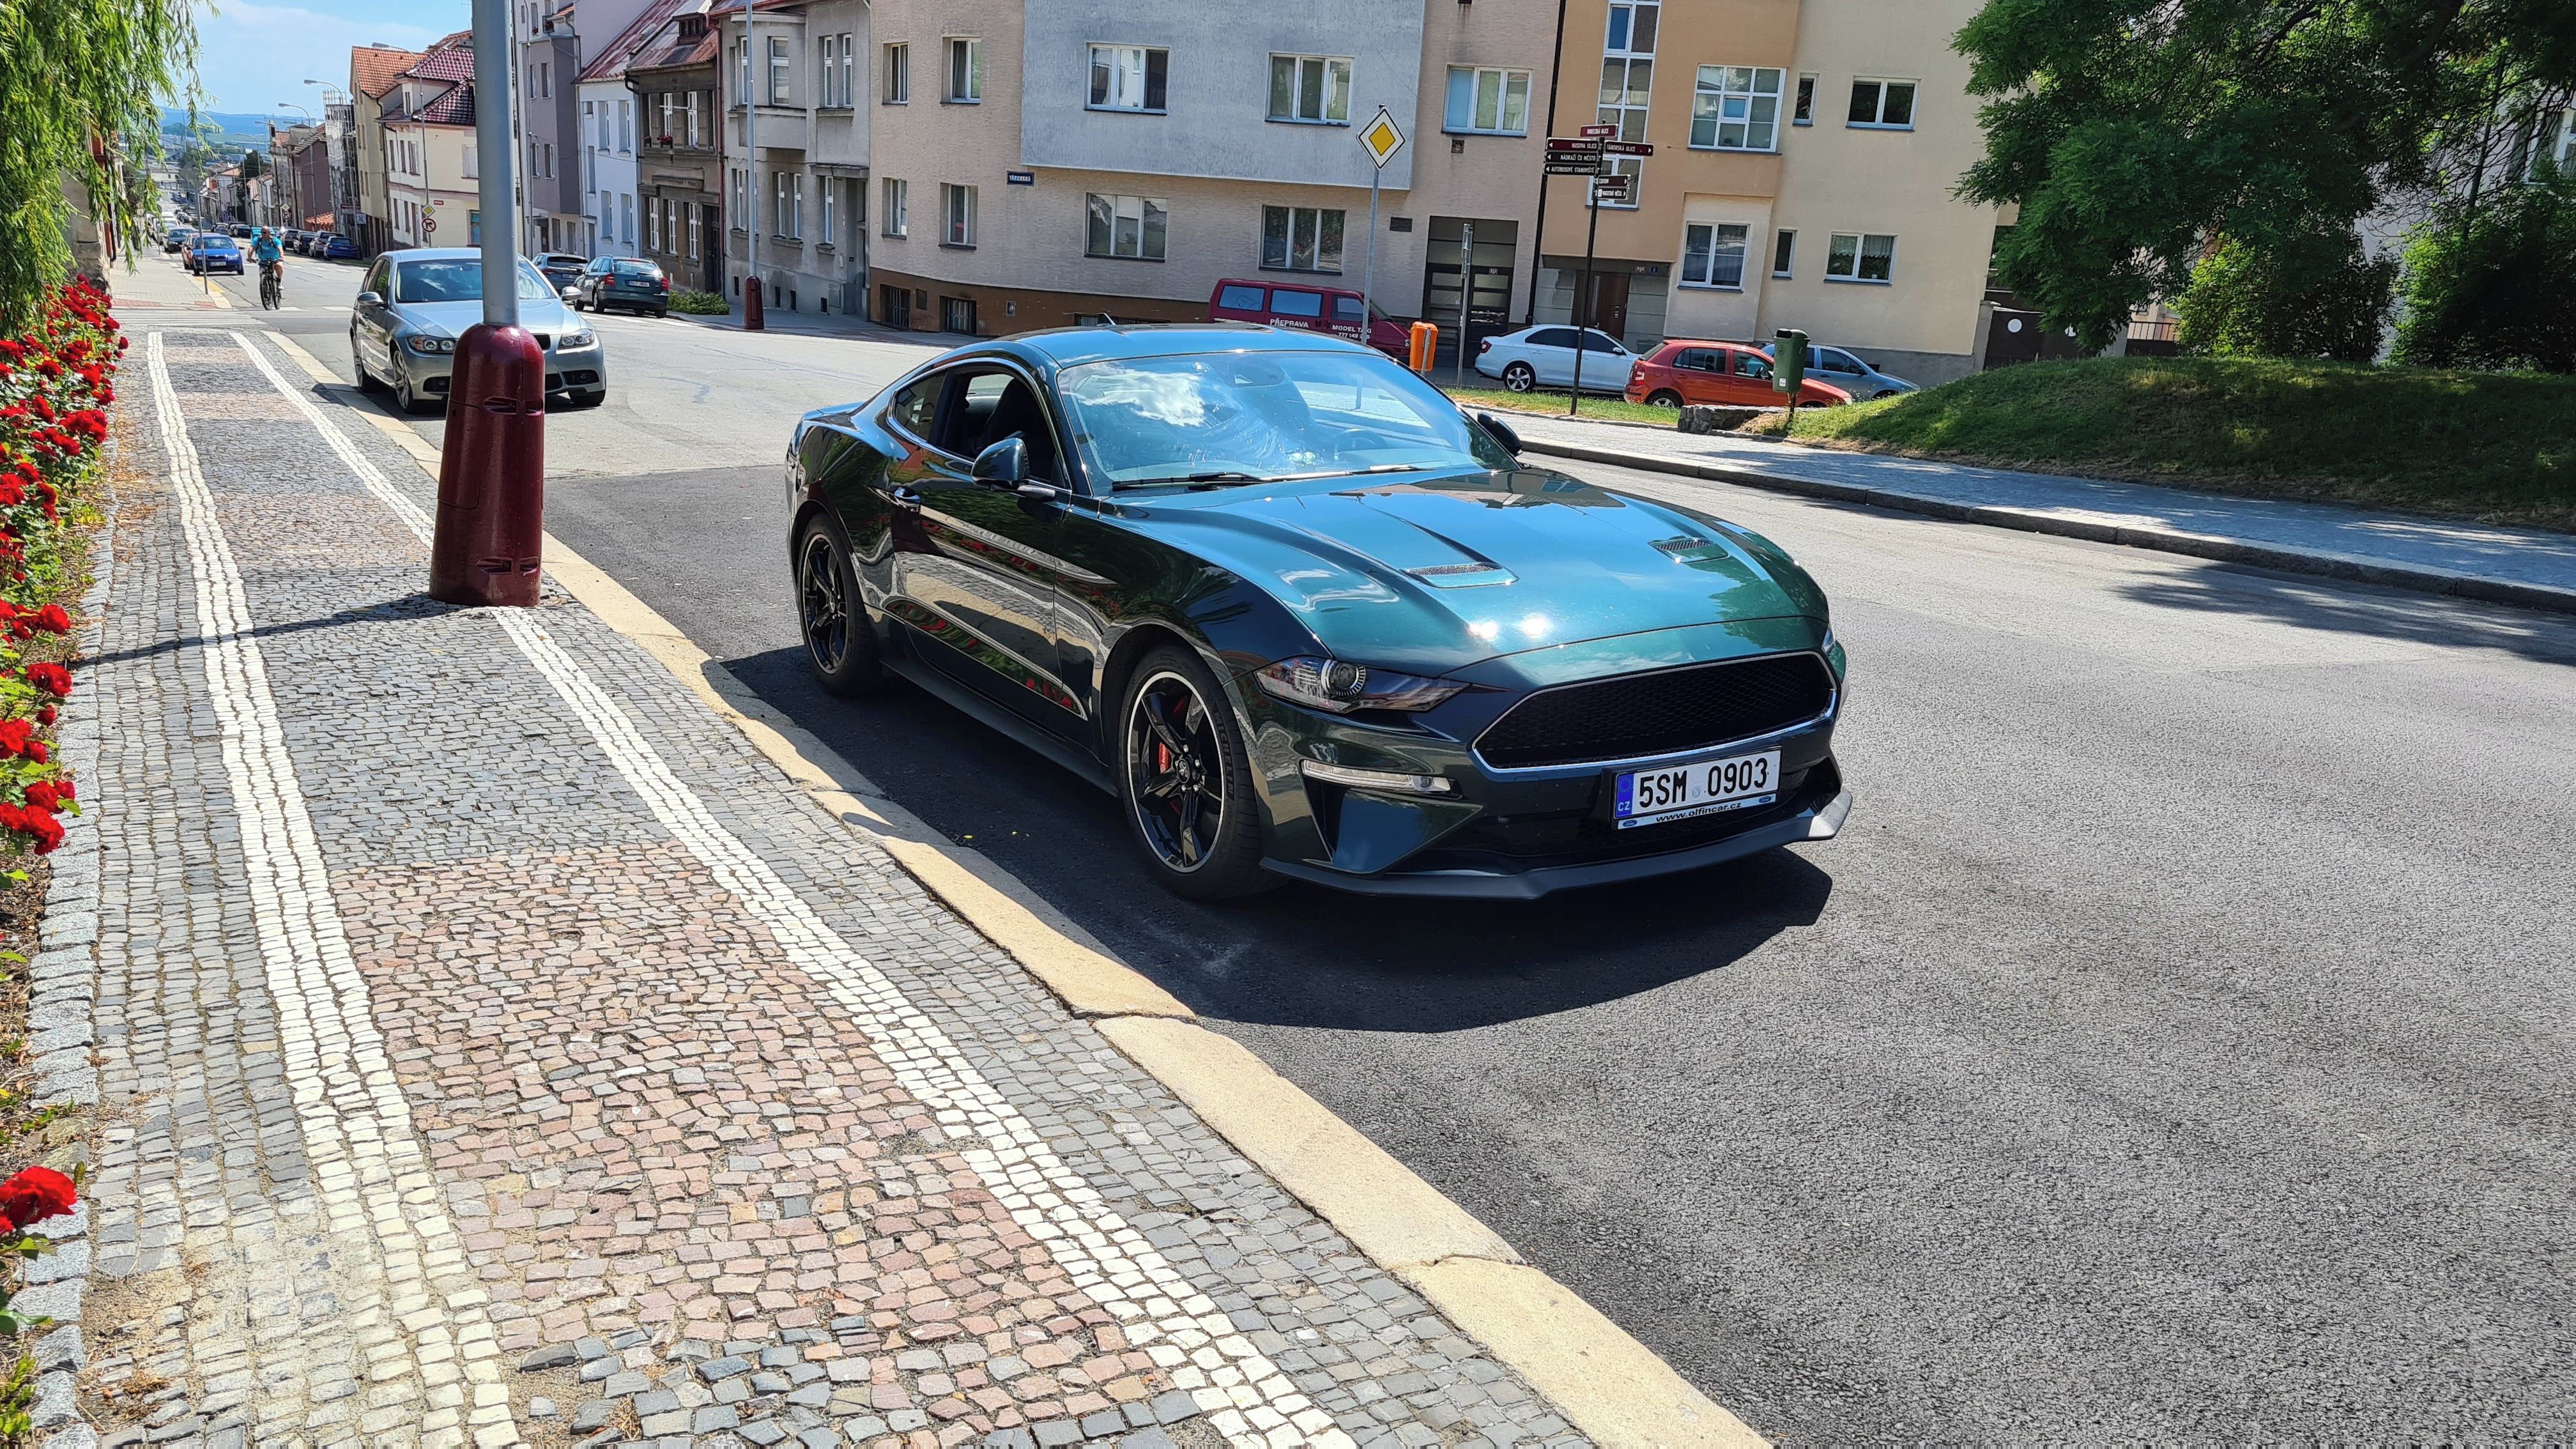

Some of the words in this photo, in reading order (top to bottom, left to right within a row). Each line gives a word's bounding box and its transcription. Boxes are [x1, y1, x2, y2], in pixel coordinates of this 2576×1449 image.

[1269, 318, 1308, 328] PŘEPRAVA
[1213, 712, 1234, 799] MICHELIN
[1639, 770, 1687, 808] 5SM
[1708, 757, 1768, 797] 0903
[1618, 801, 1630, 812] CZ
[1656, 802, 1742, 822] www.olfincar.cz
